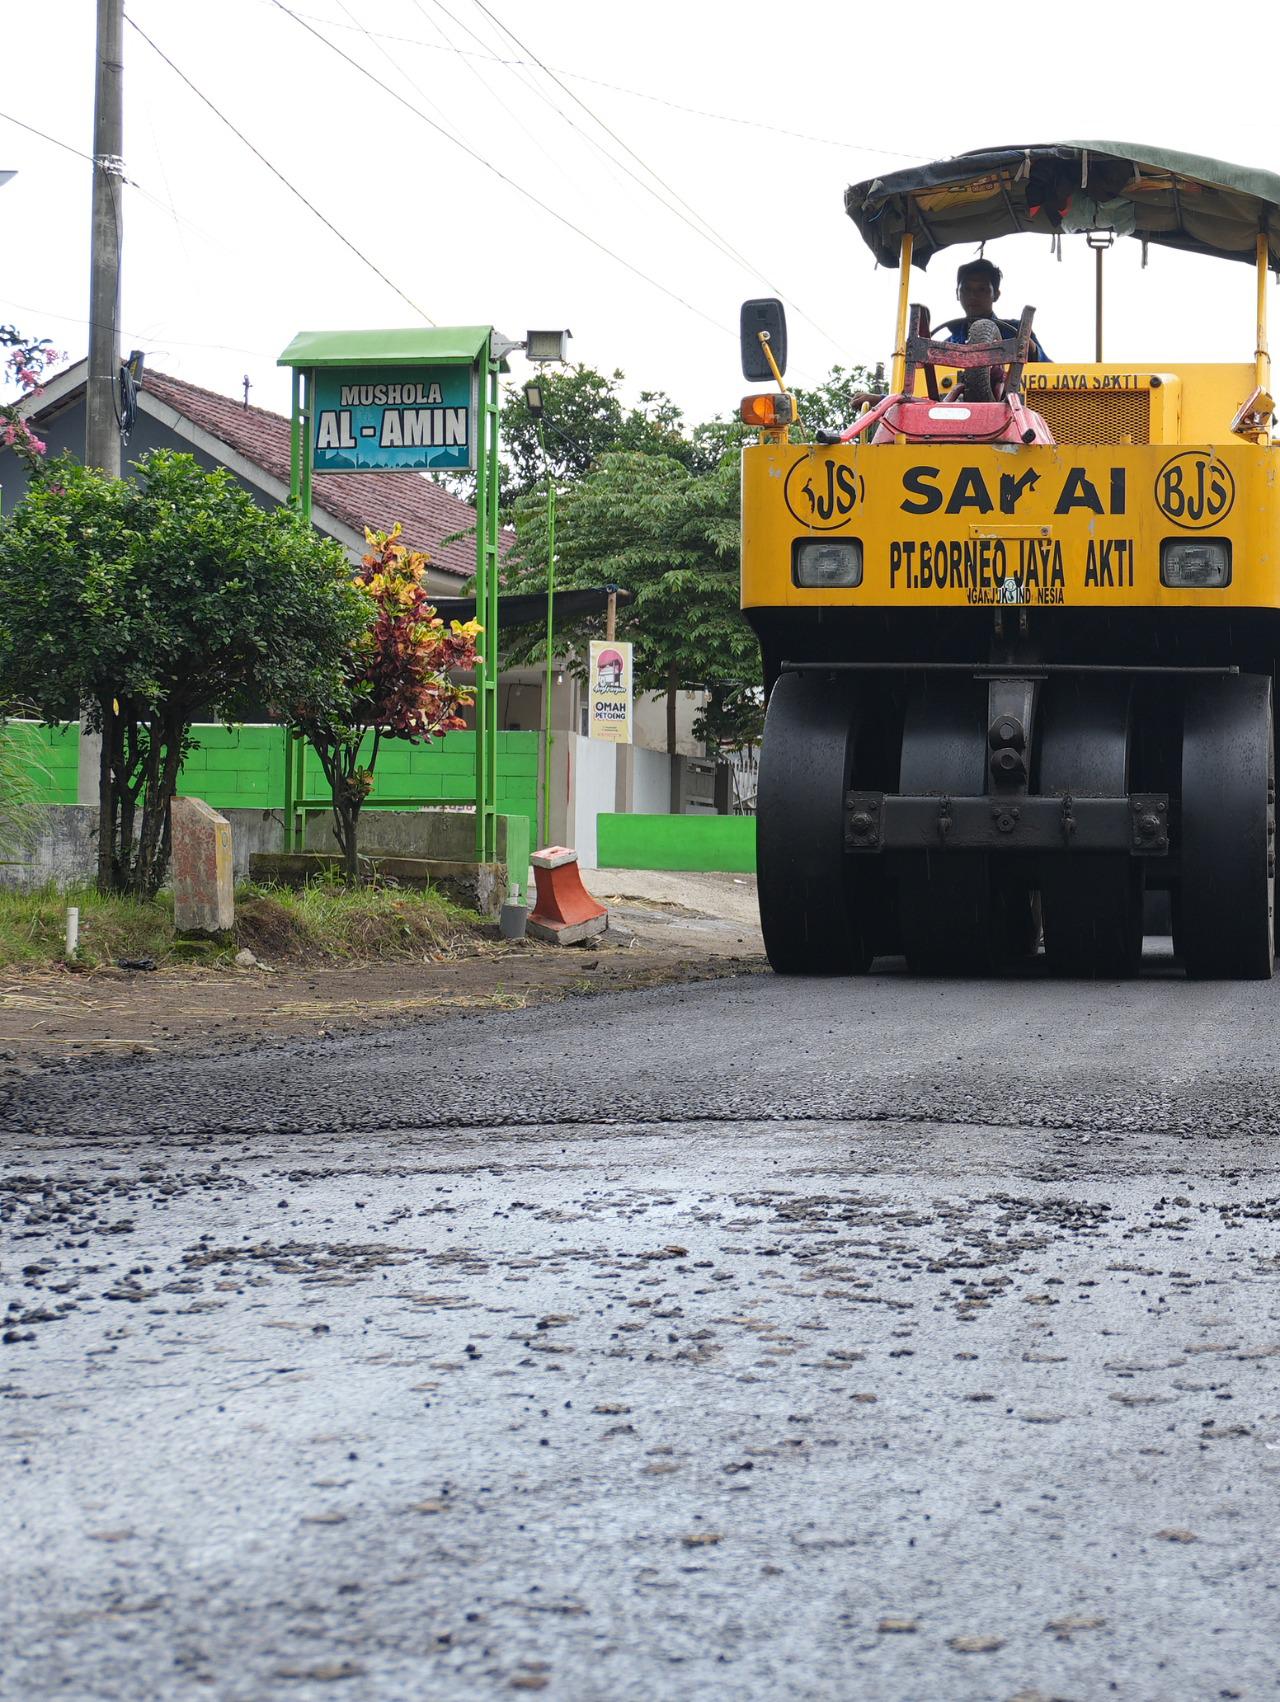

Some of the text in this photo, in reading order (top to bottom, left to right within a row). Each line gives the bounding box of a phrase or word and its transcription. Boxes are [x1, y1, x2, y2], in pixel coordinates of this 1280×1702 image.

[1052, 375, 1088, 390] JAYA
[1092, 375, 1138, 390] SAKTI
[340, 383, 443, 407] MUSHOLA
[801, 460, 857, 520] JS
[1162, 460, 1227, 520] BJS
[1013, 538, 1065, 588] JAYA
[1084, 539, 1134, 588] AKTI
[1015, 587, 1065, 604] INDNESIA
[595, 701, 626, 712] OMAH
